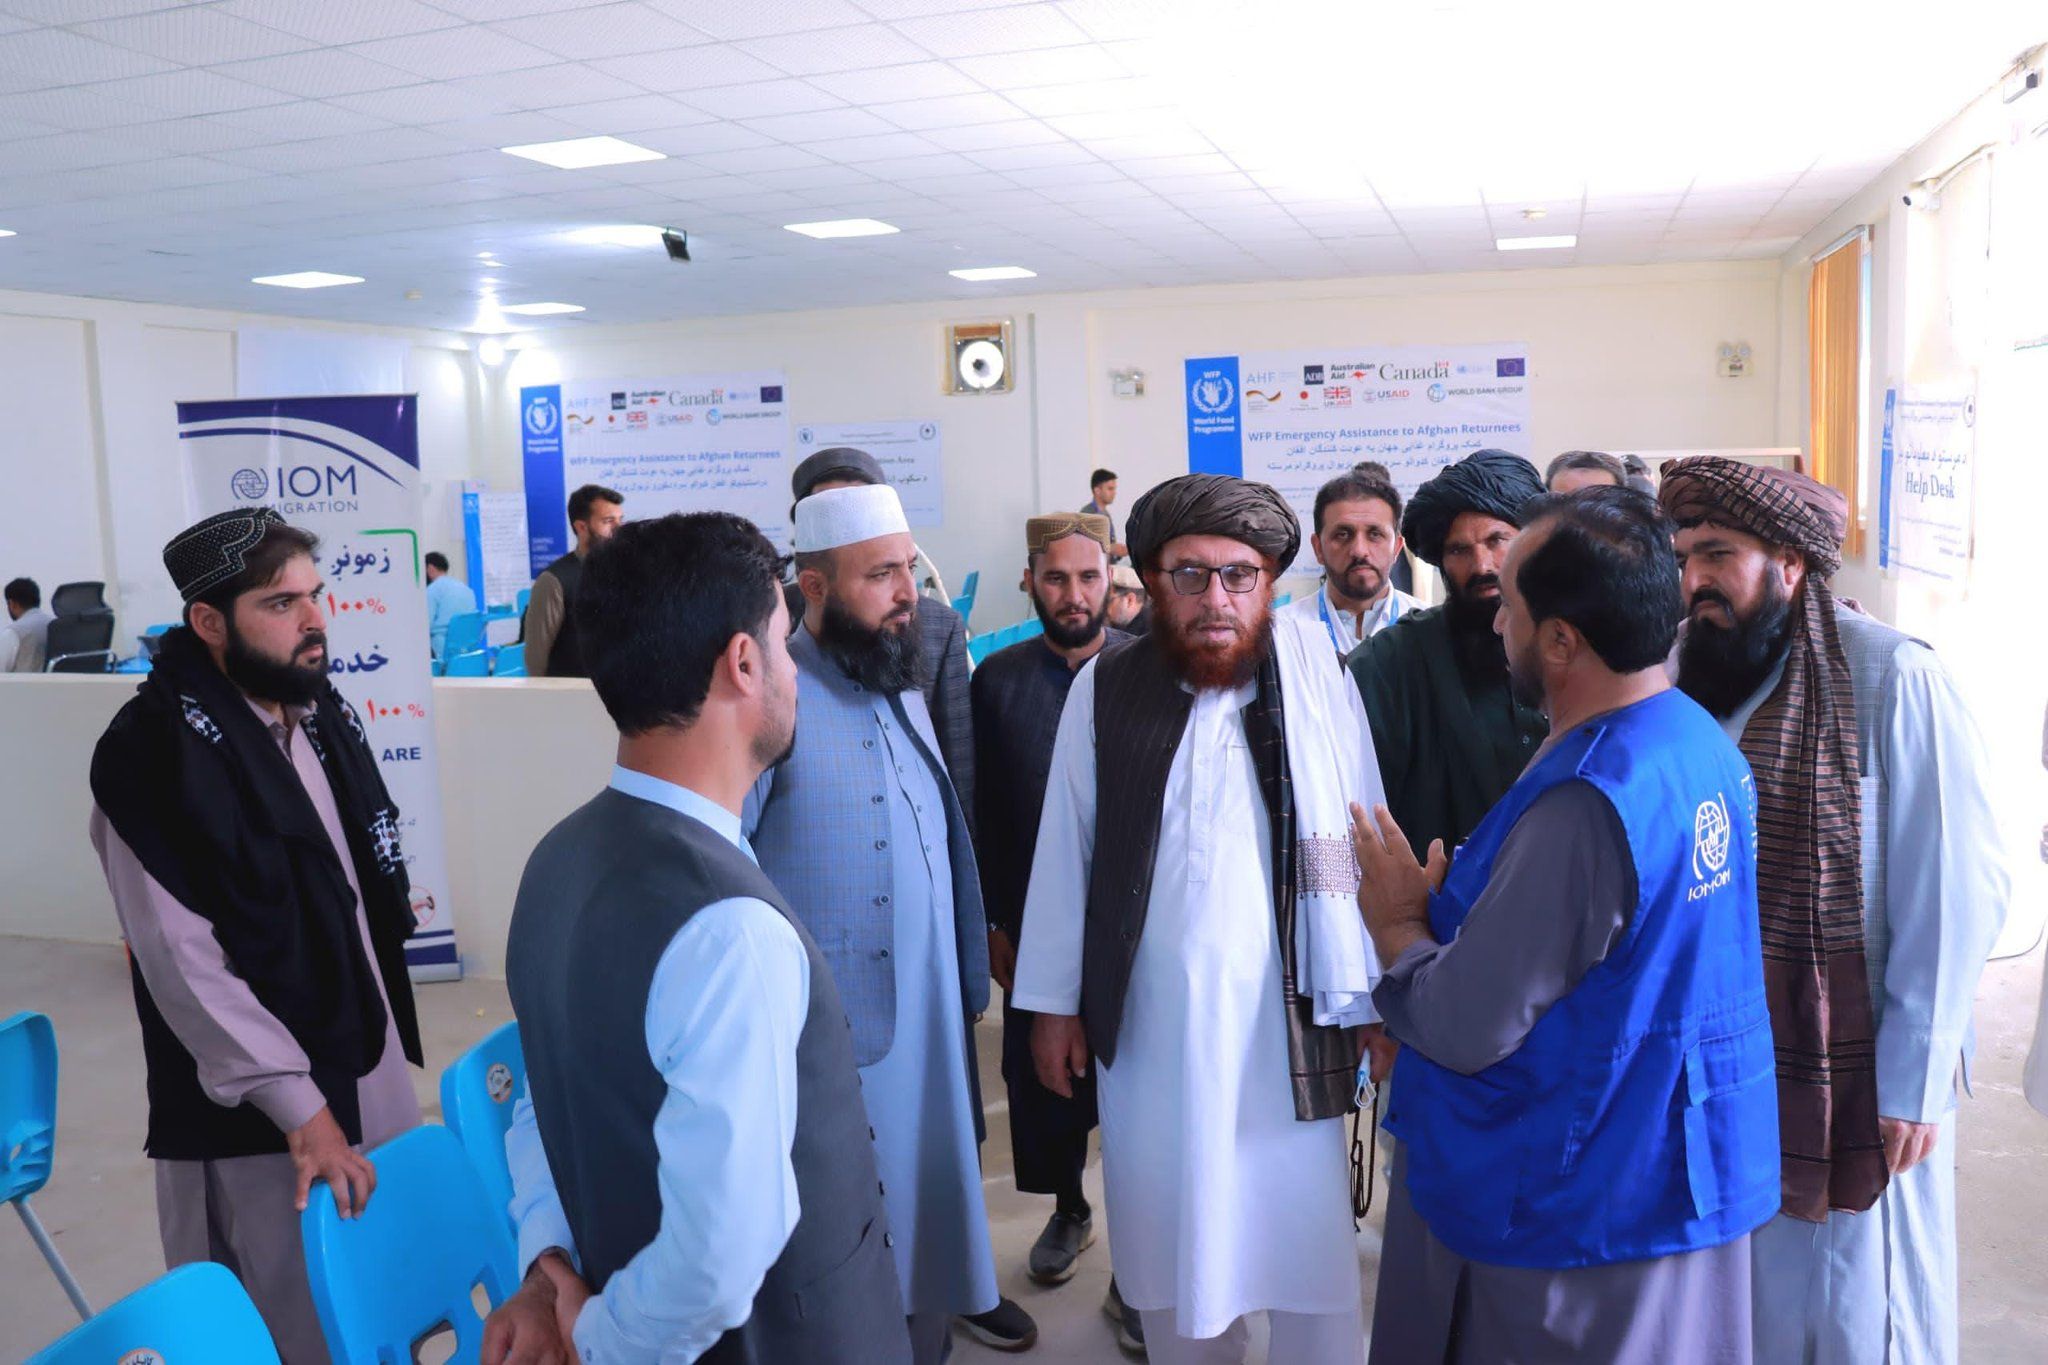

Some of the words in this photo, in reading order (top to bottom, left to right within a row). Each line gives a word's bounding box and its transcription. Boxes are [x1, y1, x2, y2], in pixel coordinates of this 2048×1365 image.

[1331, 363, 1376, 371] Australian
[1379, 361, 1449, 380] Canada
[1331, 372, 1345, 380] Aid
[669, 389, 723, 405] Canada
[1378, 390, 1409, 398] USAID
[1448, 388, 1475, 396] WORLD
[1248, 431, 1272, 441] WFP
[1275, 429, 1336, 441] Emergency
[1340, 427, 1399, 438] Assistance
[1402, 426, 1414, 436] to
[1417, 425, 1458, 438] Afghan
[1461, 423, 1521, 434] Returnees
[590, 456, 636, 466] Emergency
[639, 454, 684, 462] Assistance
[699, 451, 731, 462] Afghan
[277, 464, 357, 498] IOM
[1905, 471, 1928, 503] Help
[1931, 474, 1955, 499] Desk
[382, 747, 421, 762] ARE
